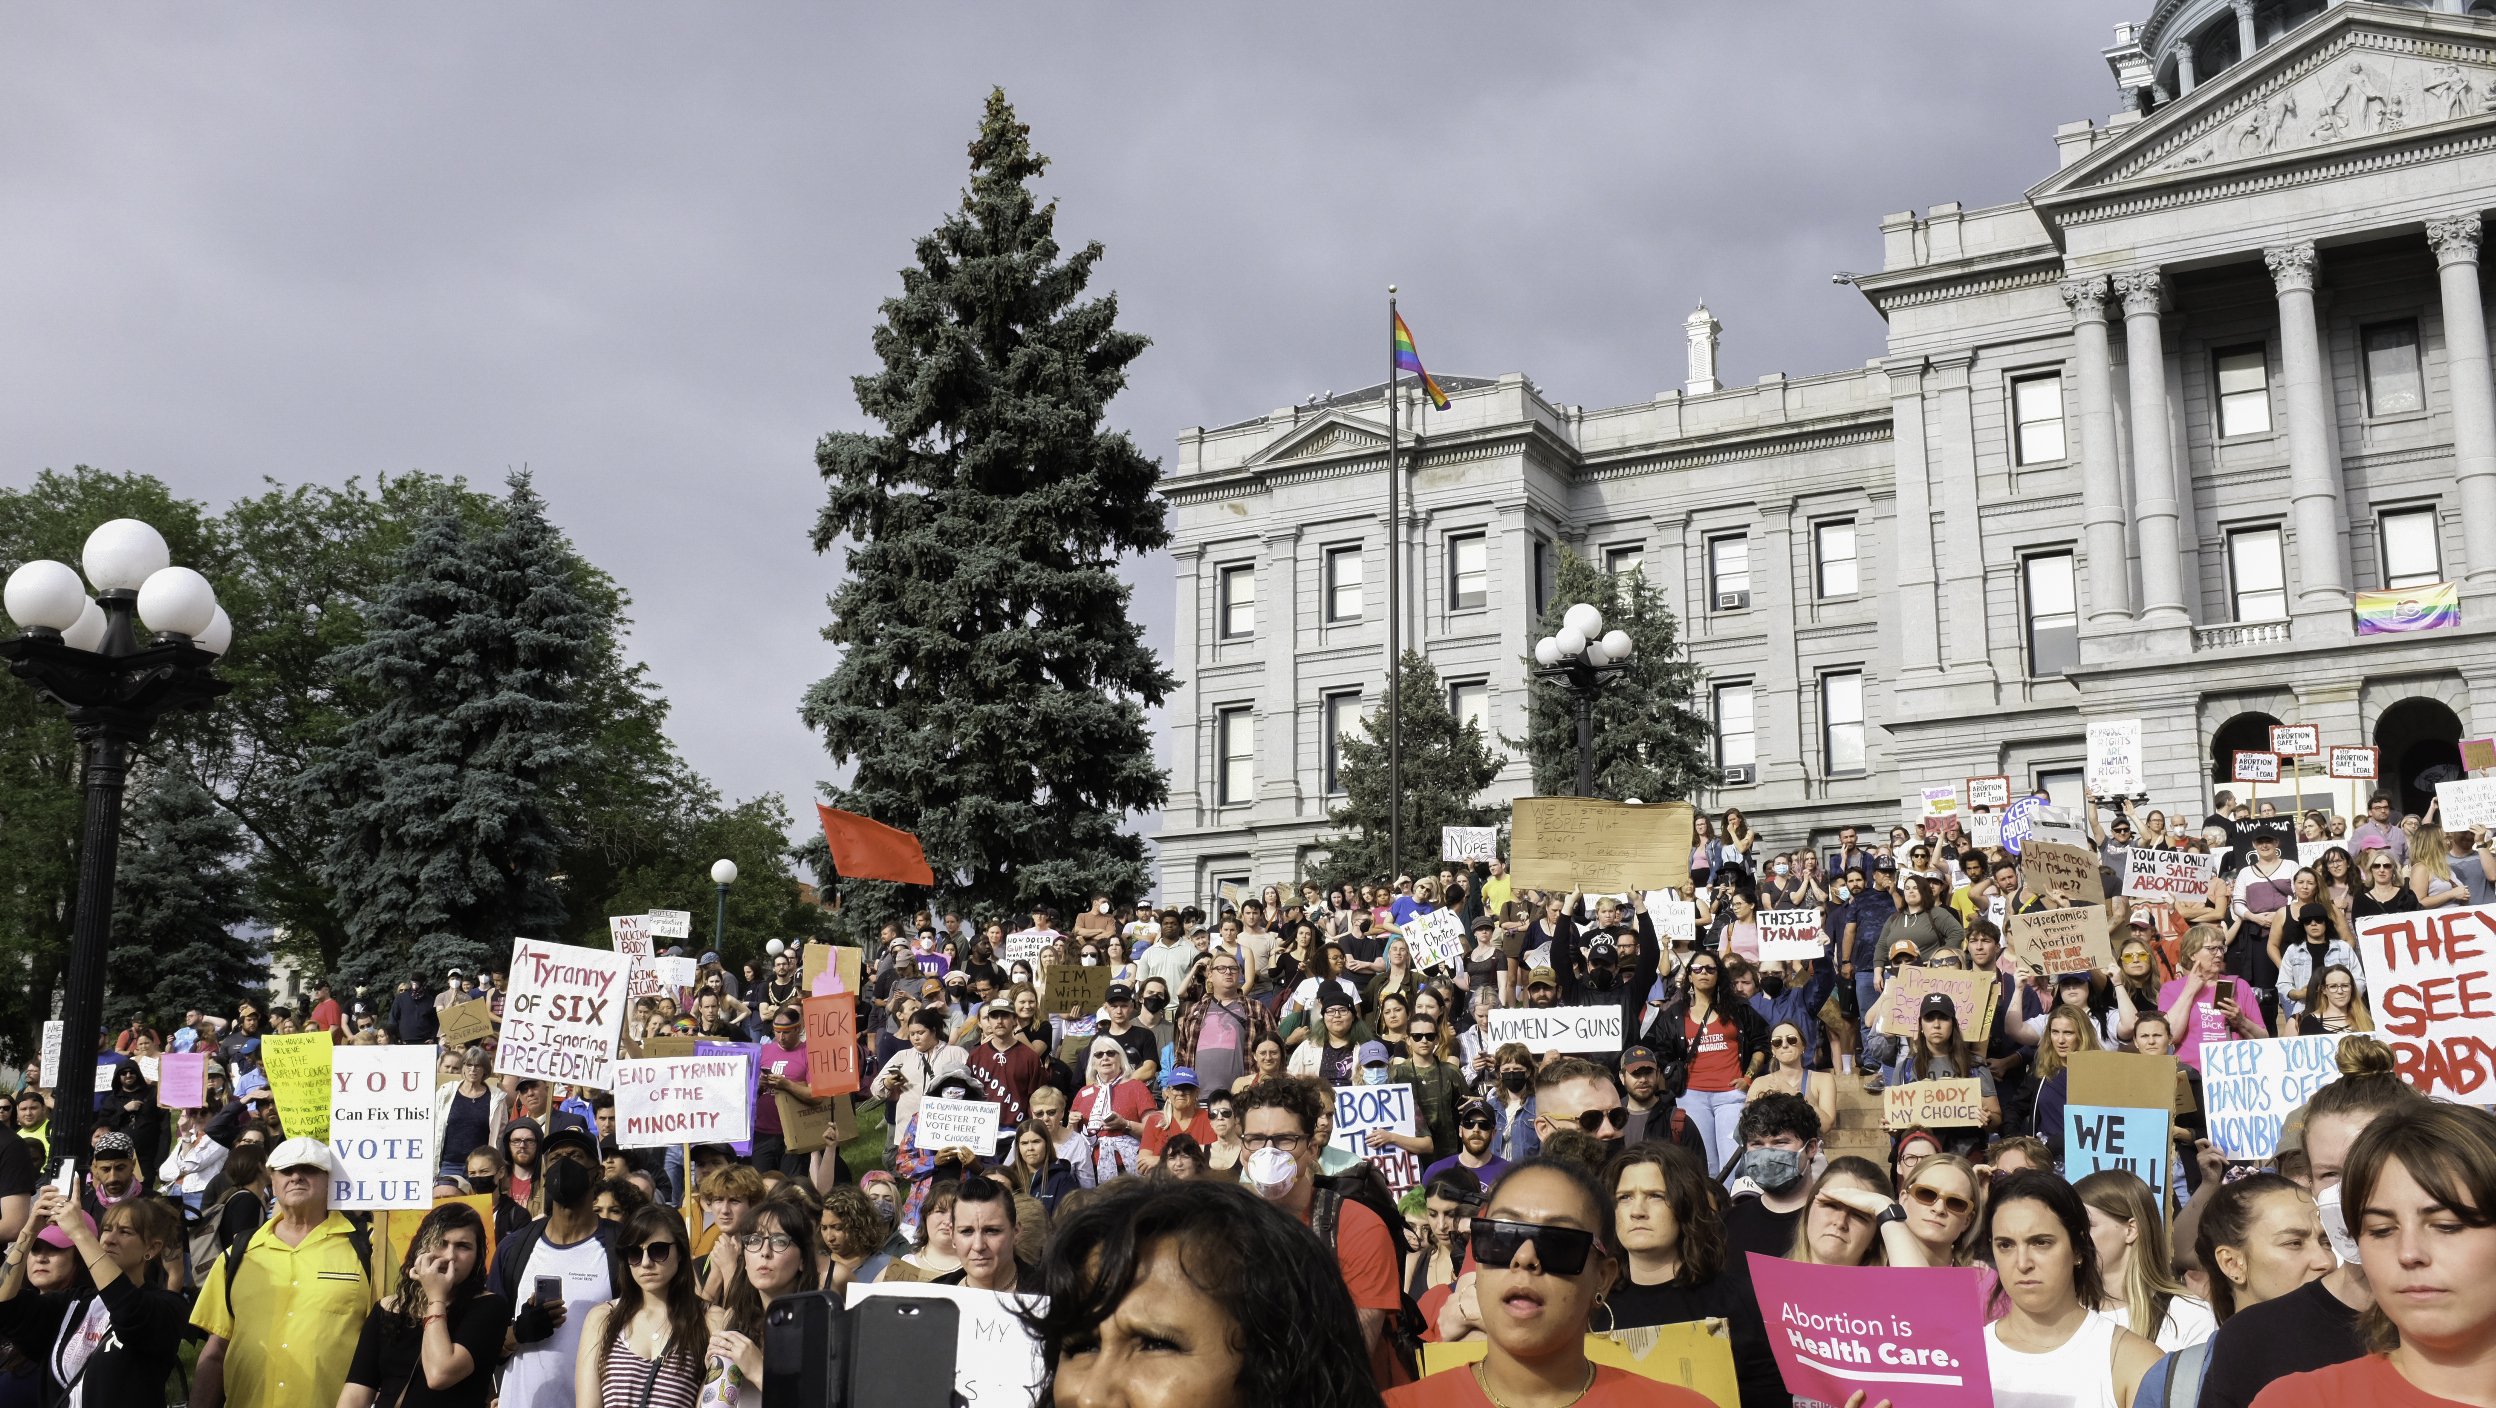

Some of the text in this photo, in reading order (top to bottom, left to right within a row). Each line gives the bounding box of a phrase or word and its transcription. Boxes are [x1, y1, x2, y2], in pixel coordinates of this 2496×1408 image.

[2276, 732, 2310, 740] ABORTION
[2101, 756, 2128, 766] HUMAN
[2098, 766, 2132, 776] RIGHTS
[2008, 798, 2040, 822] KEEP
[1535, 817, 1620, 832] PEOPLE Not
[1974, 816, 1988, 827] NO
[2236, 820, 2261, 834] Mind
[2023, 841, 2092, 870] What about
[2132, 848, 2154, 860] YOU
[2159, 852, 2180, 864] CAN
[2184, 854, 2208, 868] ONLY
[1571, 862, 1625, 878] RIGHTS
[2075, 866, 2088, 879] to
[2132, 862, 2198, 878] BAN SAFE
[2133, 876, 2209, 895] ABORTIONS
[620, 918, 638, 928] MY
[1758, 912, 1814, 925] THIS IS
[614, 929, 651, 942] FUCKING
[1404, 926, 1416, 938] My
[2044, 924, 2077, 938] prevent
[621, 941, 648, 954] BODY
[1006, 944, 1022, 952] GUN
[1410, 928, 1456, 952] My Choice
[1440, 936, 1460, 958] OFF
[2028, 934, 2085, 952] Abortion
[514, 944, 616, 998] A Tyranny
[1059, 970, 1088, 984] I'M
[628, 980, 660, 996] RIGHTS
[1055, 986, 1091, 998] With
[1905, 967, 1973, 1002] Pregnancy
[514, 994, 608, 1026] OF SIX
[2382, 970, 2496, 1038] SEE
[808, 1011, 849, 1038] FUCK
[2201, 1014, 2213, 1022] GO
[450, 1024, 490, 1040] NEVER AGAIN
[504, 1019, 608, 1058] IS Ignoring
[1489, 1018, 1548, 1042] WOMEN
[1575, 1018, 1621, 1040] GUNS
[1700, 1034, 1724, 1044] SISTERS
[273, 1046, 300, 1055] BELIEVE
[2206, 1036, 2338, 1077] KEEP YOUR
[264, 1055, 309, 1068] FUCK THE
[500, 1044, 608, 1082] PRECEDENT
[808, 1045, 854, 1074] THIS!
[272, 1064, 331, 1080] SUPREME COURT
[618, 1061, 739, 1086] END TYRANNY
[335, 1072, 420, 1092] YOU
[650, 1087, 704, 1101] OF THE
[972, 1064, 1024, 1122] COLORADO
[1892, 1087, 1970, 1107] MY BODY
[2208, 1075, 2272, 1114] HANDS
[335, 1107, 430, 1120] Can Fix This!
[926, 1112, 986, 1124] REGISTER TO
[1892, 1105, 1978, 1124] MY CHOICE
[628, 1112, 721, 1134] MINORITY
[926, 1121, 977, 1134] VOTE HERE
[931, 1132, 940, 1140] TO
[2074, 1114, 2125, 1155] WE
[334, 1138, 424, 1160] VOTE
[334, 1180, 420, 1200] BLUE
[1781, 1302, 1912, 1337] Abortion is
[975, 1318, 1011, 1343] MY
[1786, 1328, 1960, 1368] Health Care.
